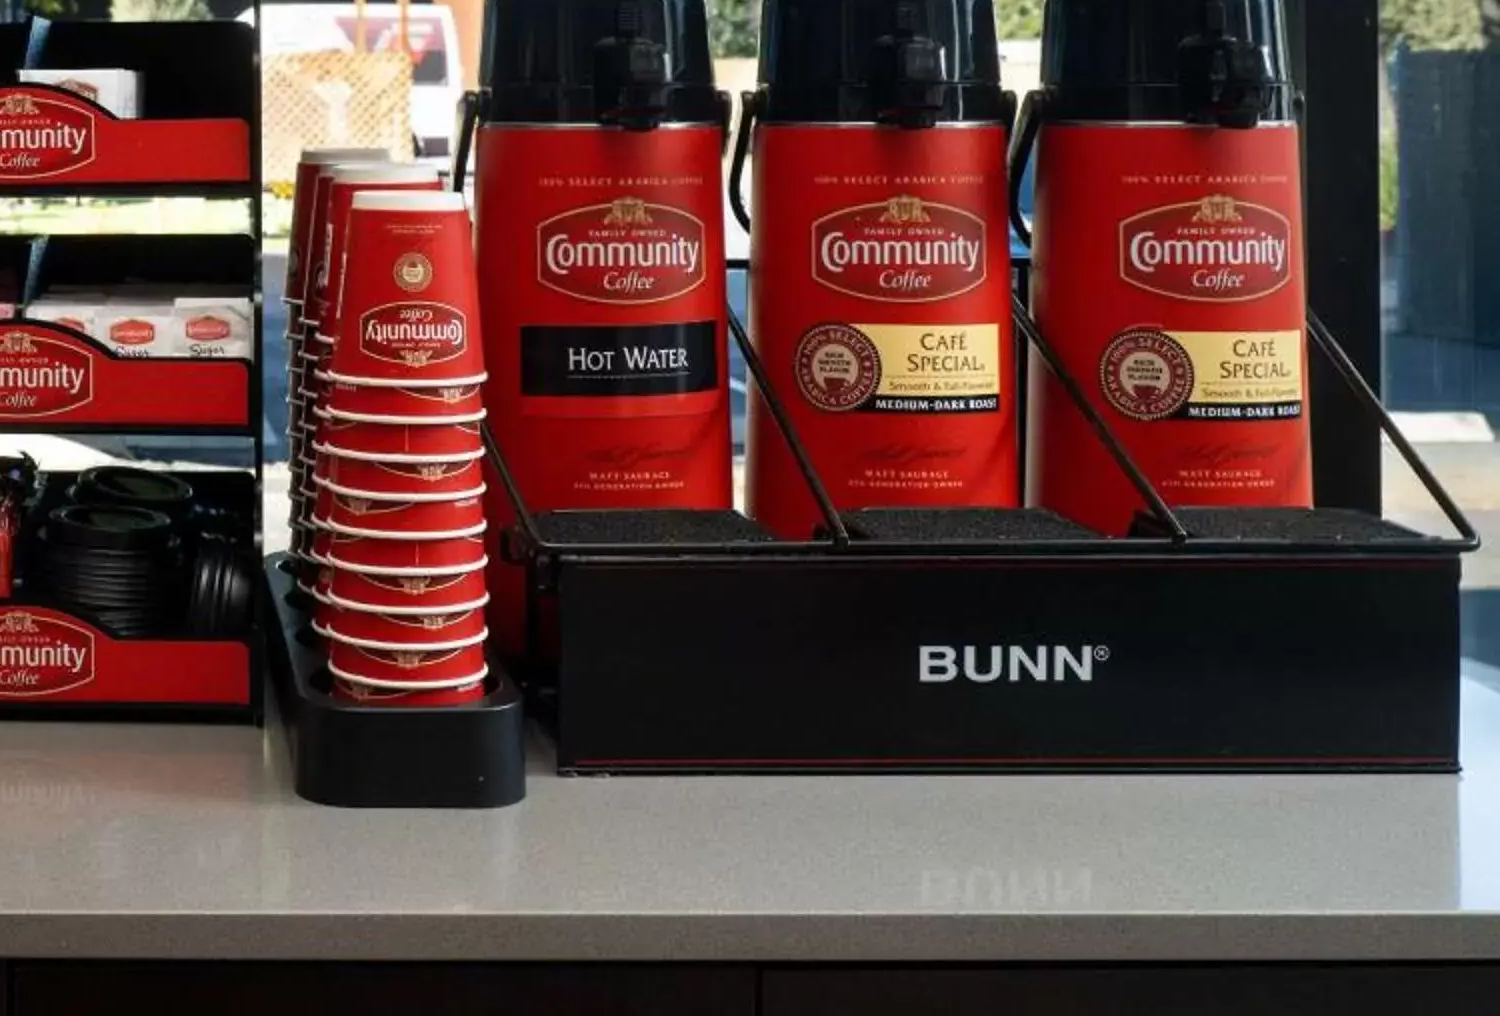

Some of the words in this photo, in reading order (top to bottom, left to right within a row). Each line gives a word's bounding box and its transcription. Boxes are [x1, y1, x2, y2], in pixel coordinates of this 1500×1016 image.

[546, 233, 699, 275] Community
[821, 231, 979, 273] Community
[1130, 231, 1285, 273] Community
[603, 271, 655, 292] Coffee
[879, 269, 932, 290] Coffee
[1192, 268, 1245, 290] Coffee
[365, 319, 462, 345] Community
[568, 347, 615, 371] HOT
[623, 345, 688, 369] WATER
[907, 354, 980, 373] SPECIAL
[1220, 361, 1287, 379] SPECIAL
